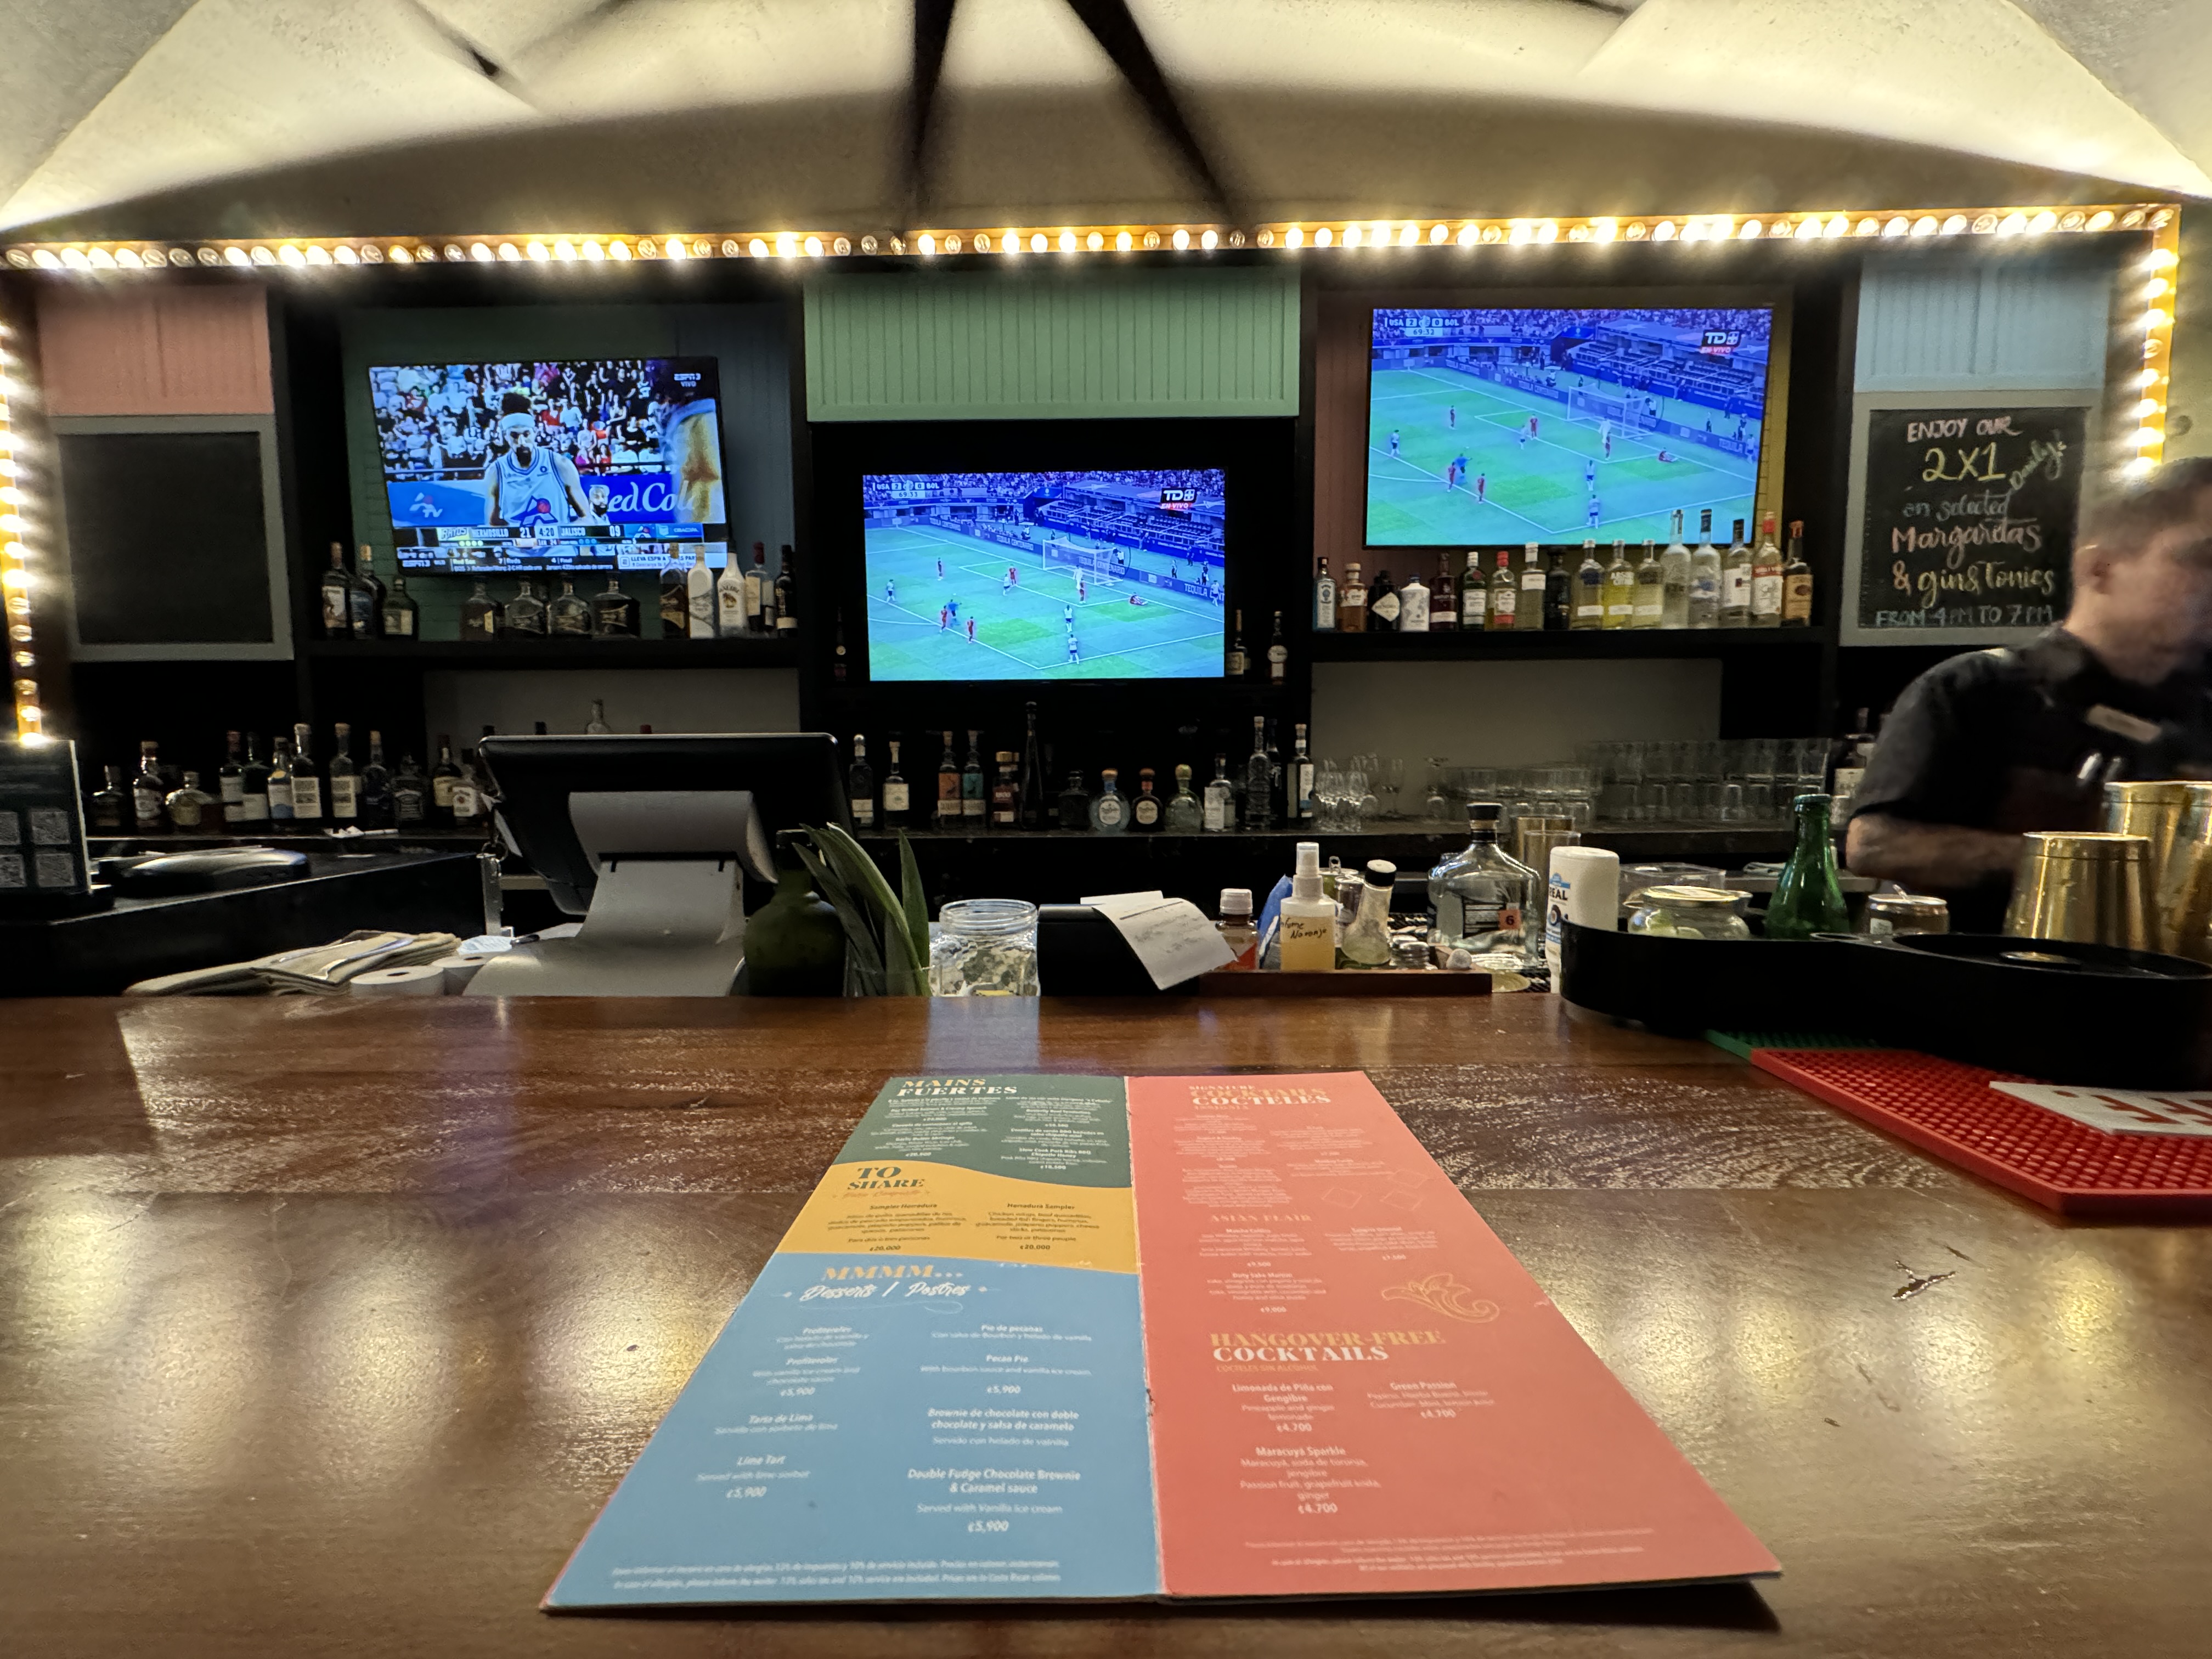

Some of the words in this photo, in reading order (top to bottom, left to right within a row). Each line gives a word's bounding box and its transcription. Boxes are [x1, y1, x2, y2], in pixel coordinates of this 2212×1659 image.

[1907, 418, 1968, 443] ENJOY
[1976, 416, 2023, 436] OUR
[1922, 442, 2006, 483] 2X1
[590, 482, 694, 512] edCol
[1936, 489, 2012, 522] selected
[441, 528, 466, 539] RAYOS
[470, 529, 509, 538] HERMOSILLO
[520, 528, 531, 538] 21
[539, 528, 555, 537] 4:20
[561, 527, 586, 536] JALISCO
[610, 526, 620, 537] 09
[1892, 517, 2042, 569] Margaritas
[1893, 560, 1912, 597] &
[1184, 583, 1207, 597] TEQUILA
[1875, 609, 1926, 628] FROM
[1980, 606, 2002, 624] TO
[2008, 605, 2022, 625] 7
[2026, 605, 2053, 624] PM
[1505, 915, 1514, 926] 6
[902, 1079, 986, 1087] MAINS
[896, 1086, 1017, 1097] FUERTES
[1190, 1088, 1327, 1097] COCKTAILS
[1192, 1095, 1331, 1106] COCTELES
[857, 1167, 901, 1179] TO
[847, 1179, 926, 1190] SHARE
[799, 1284, 878, 1302] Desserts
[904, 1282, 972, 1297] Postres
[1212, 1346, 1390, 1363] COCKTAILS
[1232, 1383, 1279, 1392] Limonada
[1280, 1383, 1292, 1392] de
[1316, 1384, 1334, 1392] con
[1390, 1381, 1419, 1391] Green
[928, 1408, 968, 1417] Brownie
[970, 1409, 983, 1418] de
[984, 1409, 1030, 1418] chocolate
[1031, 1410, 1049, 1419] con
[1051, 1411, 1079, 1420] doble
[931, 1421, 978, 1429] chocolate
[988, 1421, 1013, 1430] salsa
[1014, 1421, 1027, 1430] de
[1029, 1423, 1075, 1431] caramelo
[1307, 1446, 1346, 1458] Sparkle
[907, 1469, 946, 1479] Double
[948, 1469, 981, 1481] Fudge
[984, 1469, 1035, 1480] Chocolate
[1037, 1470, 1081, 1481] Brownie
[950, 1483, 958, 1493] &
[960, 1483, 1005, 1493] Caramel
[1007, 1484, 1038, 1493] sauce
